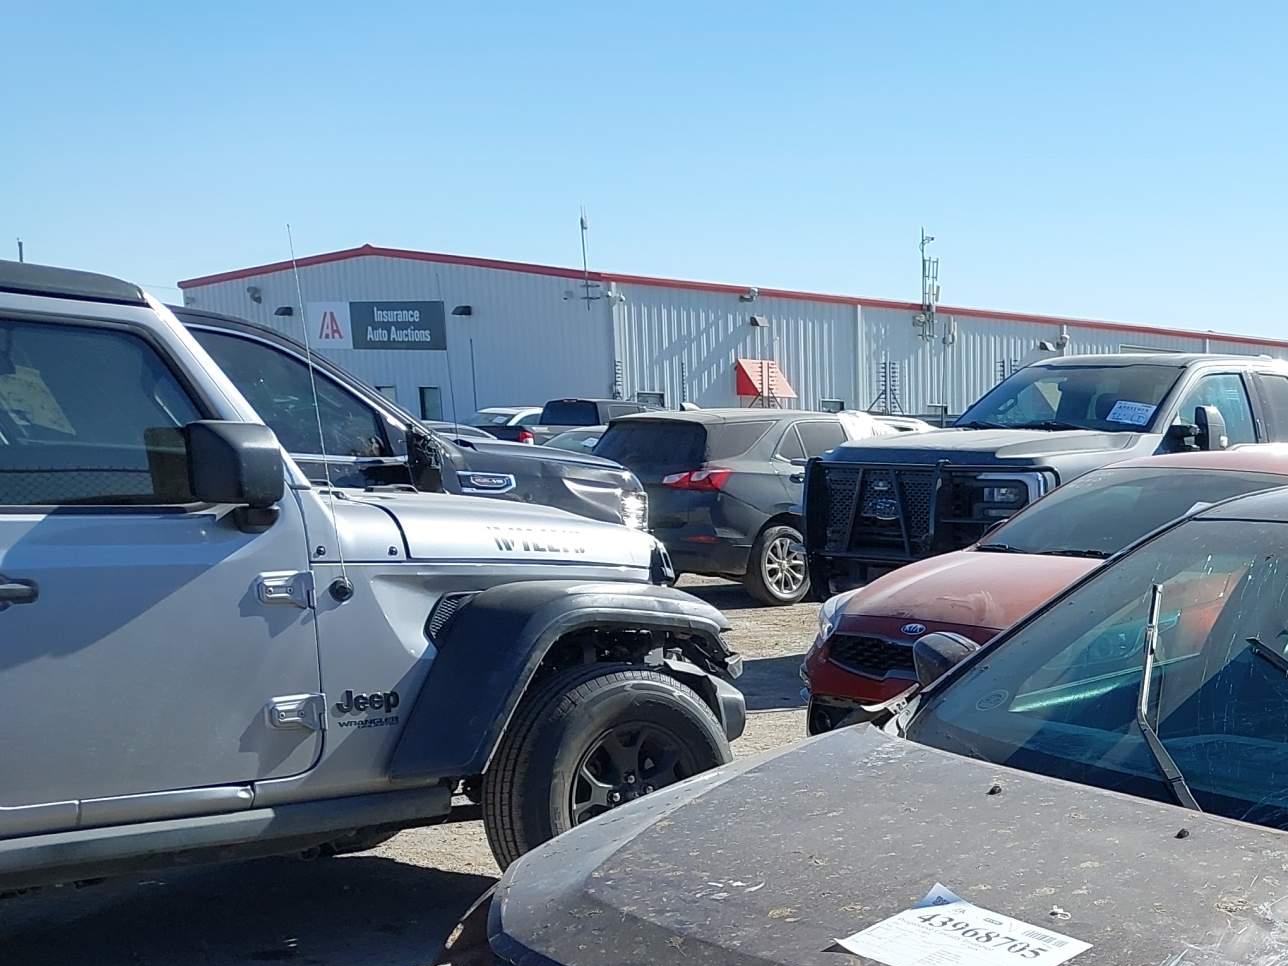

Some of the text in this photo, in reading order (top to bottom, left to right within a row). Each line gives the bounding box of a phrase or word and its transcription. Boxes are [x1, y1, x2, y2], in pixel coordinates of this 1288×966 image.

[373, 306, 420, 322] Insurance
[367, 326, 431, 342] Auto Auctions
[335, 690, 400, 714] Jeep
[337, 716, 400, 728] WRANGLER
[917, 913, 1049, 959] 43968705
